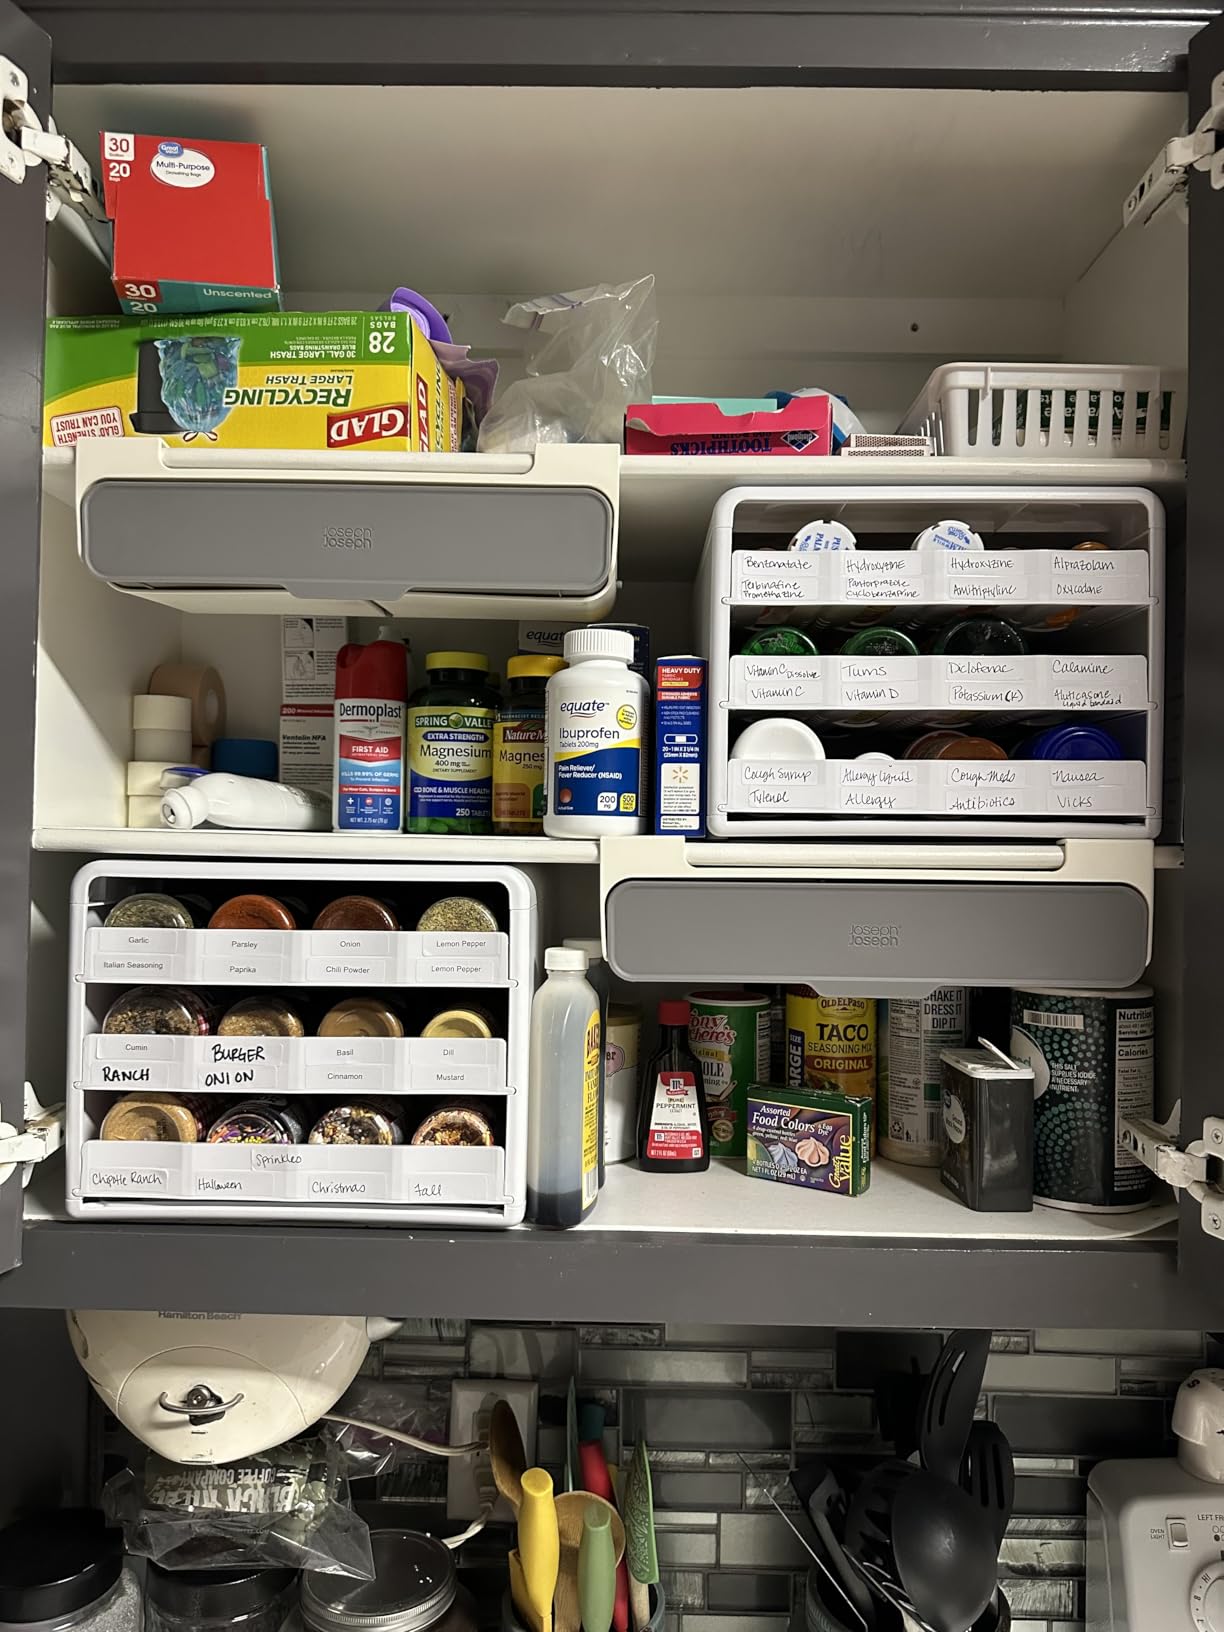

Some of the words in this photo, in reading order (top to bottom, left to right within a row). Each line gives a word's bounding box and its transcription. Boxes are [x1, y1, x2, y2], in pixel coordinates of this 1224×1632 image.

[108, 137, 130, 153] 30
[108, 163, 131, 177] 20
[156, 160, 211, 172] Multi-Purpose
[125, 284, 156, 298] 30
[203, 288, 272, 299] Unscented
[130, 302, 158, 313] 20
[369, 321, 396, 329] BAGS
[369, 331, 396, 353] 28
[270, 350, 297, 358] TRASH
[298, 350, 325, 358] LARGE
[326, 350, 345, 358] GAL.
[346, 350, 357, 358] 30
[265, 375, 307, 386] TRASH
[311, 375, 353, 385] LARGE
[225, 388, 353, 408] RECYCLING
[55, 418, 81, 432] TRUST
[82, 415, 99, 428] CAN
[100, 412, 118, 426] YOU
[331, 408, 404, 444] GLAD
[670, 438, 772, 455] TOOTHPICKS
[744, 556, 812, 570] Benzonatate
[1054, 556, 1115, 572] Alprazolam
[527, 631, 565, 646] equat
[842, 665, 888, 677] Tums
[949, 661, 1014, 675] Diclofenac
[1052, 659, 1115, 675] Calamine
[751, 686, 794, 700] Vitamin
[793, 685, 806, 697] C
[845, 688, 887, 702] Vitamin
[888, 687, 900, 699] D
[951, 685, 1004, 702] Potassium
[1004, 689, 1025, 703] (K)
[282, 707, 297, 715] 200
[340, 702, 402, 722] Dermoplast
[560, 699, 605, 715] equate
[415, 716, 448, 727] SPRING
[282, 734, 311, 742] Ventolin
[427, 732, 450, 741] EXTRA
[450, 732, 485, 742] STRENGTH
[504, 728, 537, 741] Nature
[559, 727, 620, 740] Ibuprofen
[352, 745, 373, 754] FIRST
[375, 745, 390, 754] AID
[559, 741, 577, 749] Tablets
[577, 741, 599, 749] 200mg
[420, 744, 492, 760] Magnesium
[500, 750, 545, 764] Magnes
[450, 761, 461, 769] mg
[558, 771, 573, 779] Fever
[572, 771, 598, 779] Reducer
[598, 772, 623, 780] (NSAID)
[744, 765, 776, 782] Cough
[777, 768, 812, 782] Syrup
[842, 768, 878, 785] Allergy
[951, 767, 988, 787] Cough
[1052, 769, 1106, 783] Nausea
[600, 795, 616, 804] 200
[622, 795, 635, 803] 500
[844, 792, 897, 809] Allergy
[949, 794, 1016, 811] Antibiotics
[1056, 794, 1094, 809] Vicks
[455, 808, 471, 817] 250
[128, 936, 150, 945] Garlic
[231, 940, 259, 950] Parsley
[339, 940, 362, 949] Onion
[436, 940, 460, 948] Lemon
[461, 940, 487, 950] Pepper
[103, 961, 126, 969] Italian
[126, 961, 164, 971] Seasoning
[229, 966, 257, 975] Paprika
[343, 966, 370, 975] Powder
[431, 965, 455, 973] Lemon
[456, 965, 482, 975] Pepper
[821, 998, 838, 1009] OLD
[837, 998, 850, 1008] EL
[924, 1003, 955, 1016] DRESS
[955, 1003, 962, 1016] IT
[932, 1017, 948, 1029] DIP
[949, 1017, 957, 1029] IT
[815, 1022, 869, 1043] TACO
[125, 1044, 149, 1052] Cumin
[211, 1043, 266, 1064] BURGER
[336, 1049, 355, 1057] Basil
[442, 1049, 455, 1057] Dill
[808, 1042, 860, 1054] SEASONING
[860, 1043, 872, 1053] MIX
[1118, 1048, 1149, 1057] Calories
[789, 1043, 802, 1088] ARGE
[813, 1057, 869, 1070] ORIGINAL
[102, 1065, 150, 1082] RANCH
[327, 1072, 364, 1081] Cinnamon
[436, 1072, 465, 1081] Mustard
[1051, 1070, 1077, 1078] SUPPLIES
[1056, 1078, 1088, 1086] NECESSARY
[760, 1105, 792, 1117] Assorted
[752, 1112, 781, 1128] Food
[781, 1116, 816, 1133] Colors
[822, 1122, 834, 1132] Egg
[256, 1153, 302, 1169] Sprinkles
[839, 1134, 852, 1182] Value
[92, 1171, 128, 1187] Chipotle
[131, 1170, 163, 1186] Ranch
[198, 1178, 243, 1191] Halloween
[311, 1181, 367, 1195] Christmas
[158, 1310, 206, 1320] Hamilton
[206, 1312, 242, 1321] Beach
[238, 1467, 276, 1485] COFFEE
[1201, 1572, 1212, 1584] HI
